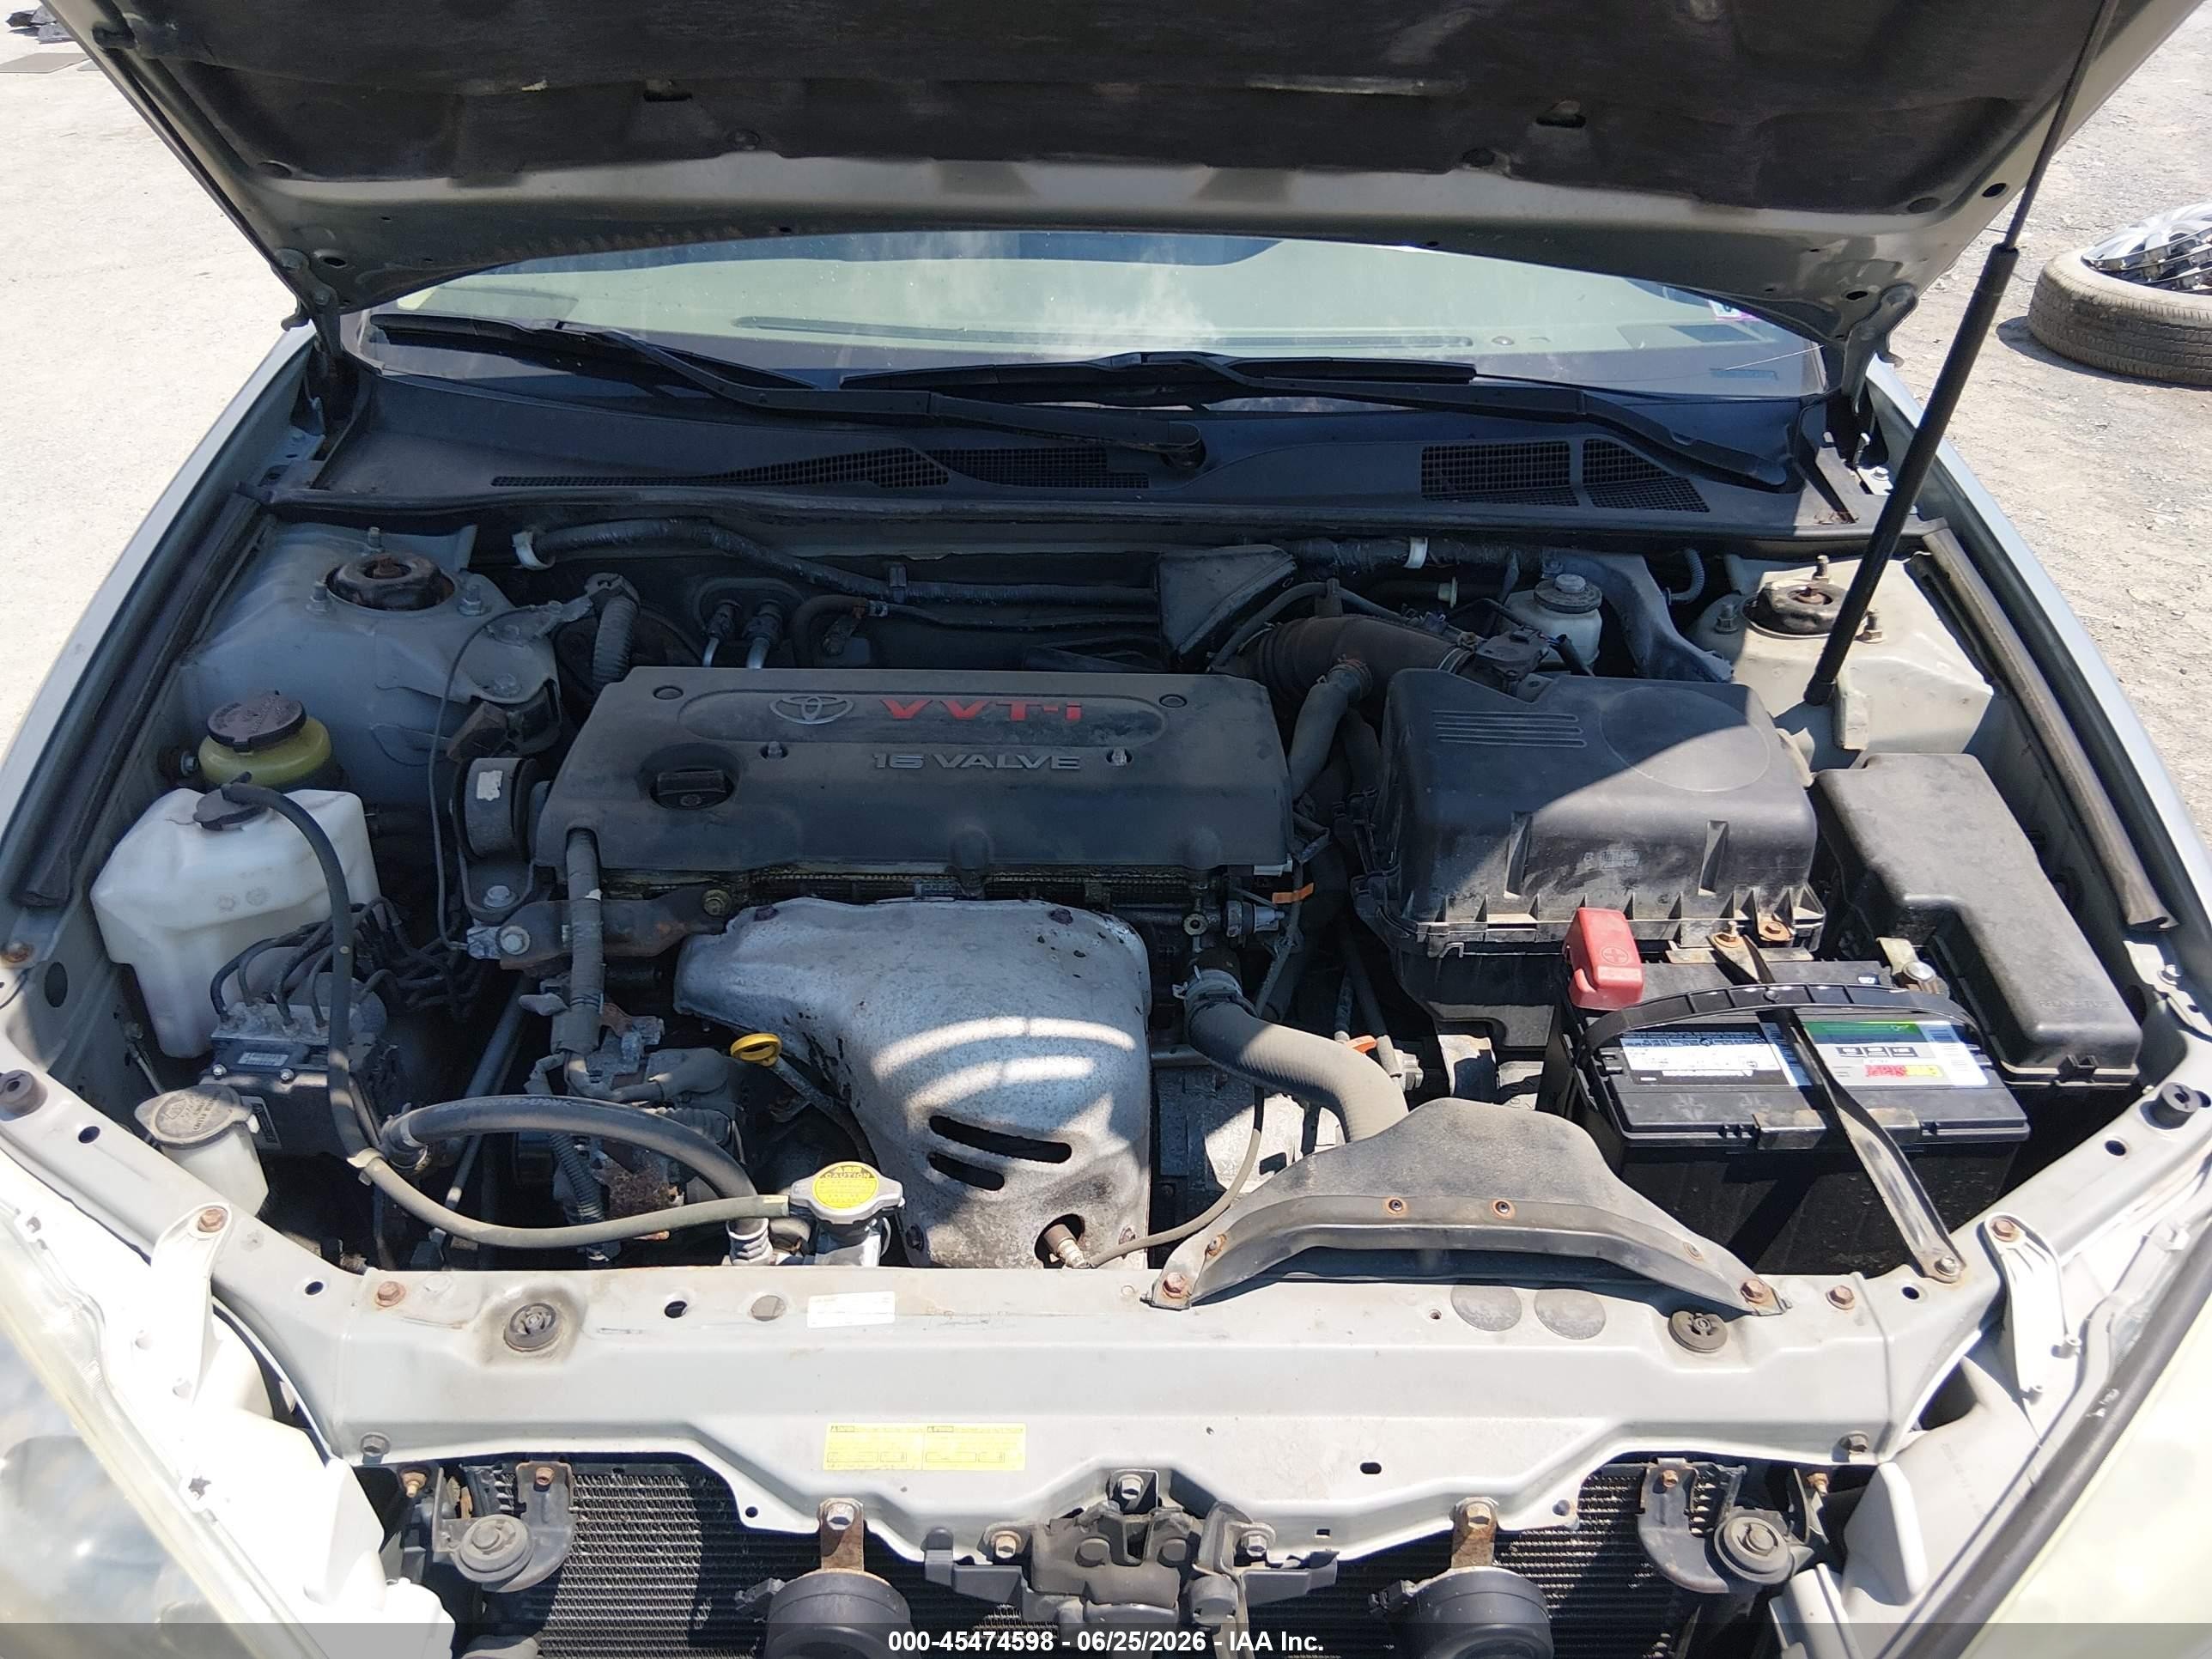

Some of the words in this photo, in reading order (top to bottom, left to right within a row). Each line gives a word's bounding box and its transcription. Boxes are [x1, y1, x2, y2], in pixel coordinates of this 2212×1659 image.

[879, 699, 1082, 721] VVT-i
[873, 753, 925, 769] 16
[933, 753, 1080, 770] VALVE
